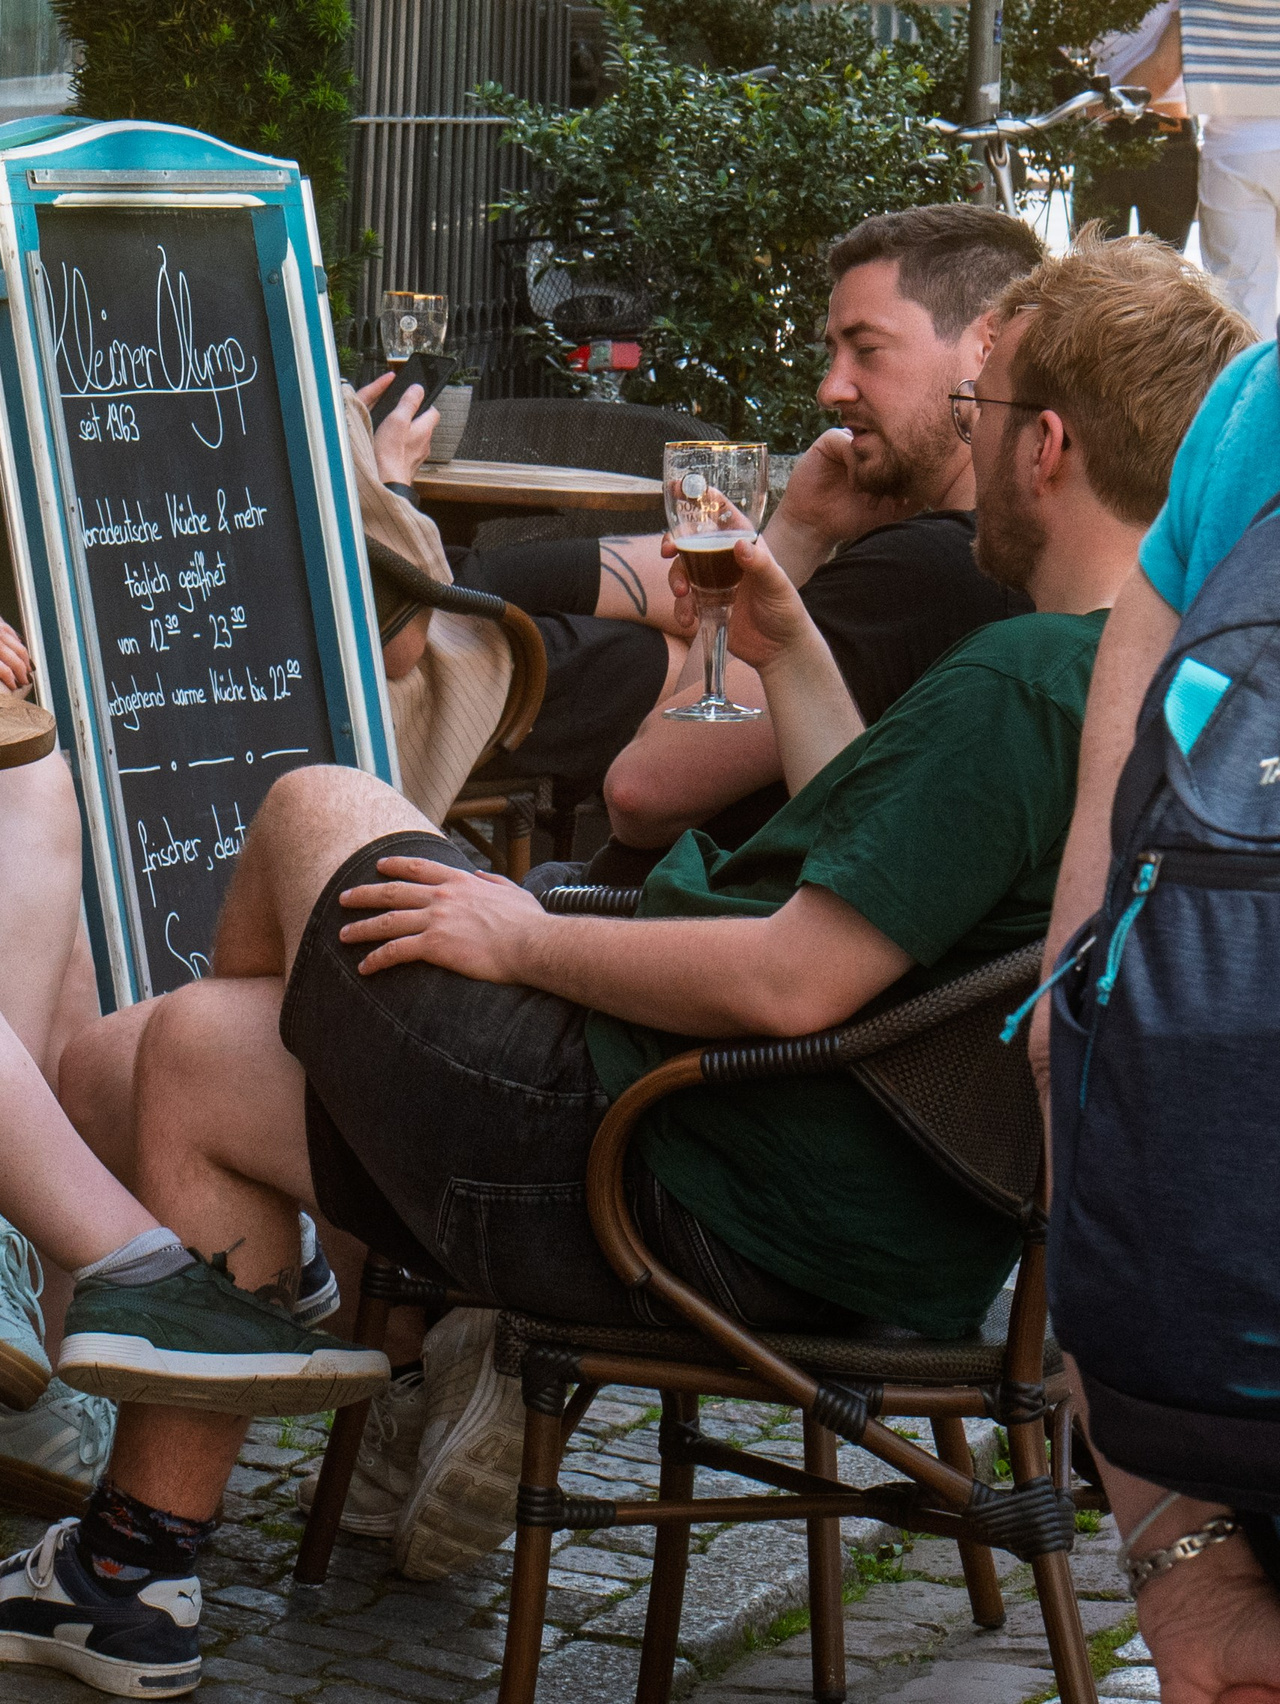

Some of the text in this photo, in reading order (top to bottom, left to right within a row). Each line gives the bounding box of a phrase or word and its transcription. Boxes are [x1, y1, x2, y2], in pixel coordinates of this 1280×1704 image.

[40, 244, 247, 449] Kleiner Olymp
[78, 402, 140, 442] seit 1963
[165, 492, 211, 539] Küche
[217, 488, 231, 534] &
[233, 487, 267, 530] mehr
[124, 551, 226, 613] täglich geöffnet
[117, 637, 141, 655] von
[172, 688, 207, 707] warme
[209, 667, 246, 704] Küche
[246, 666, 267, 703] bis
